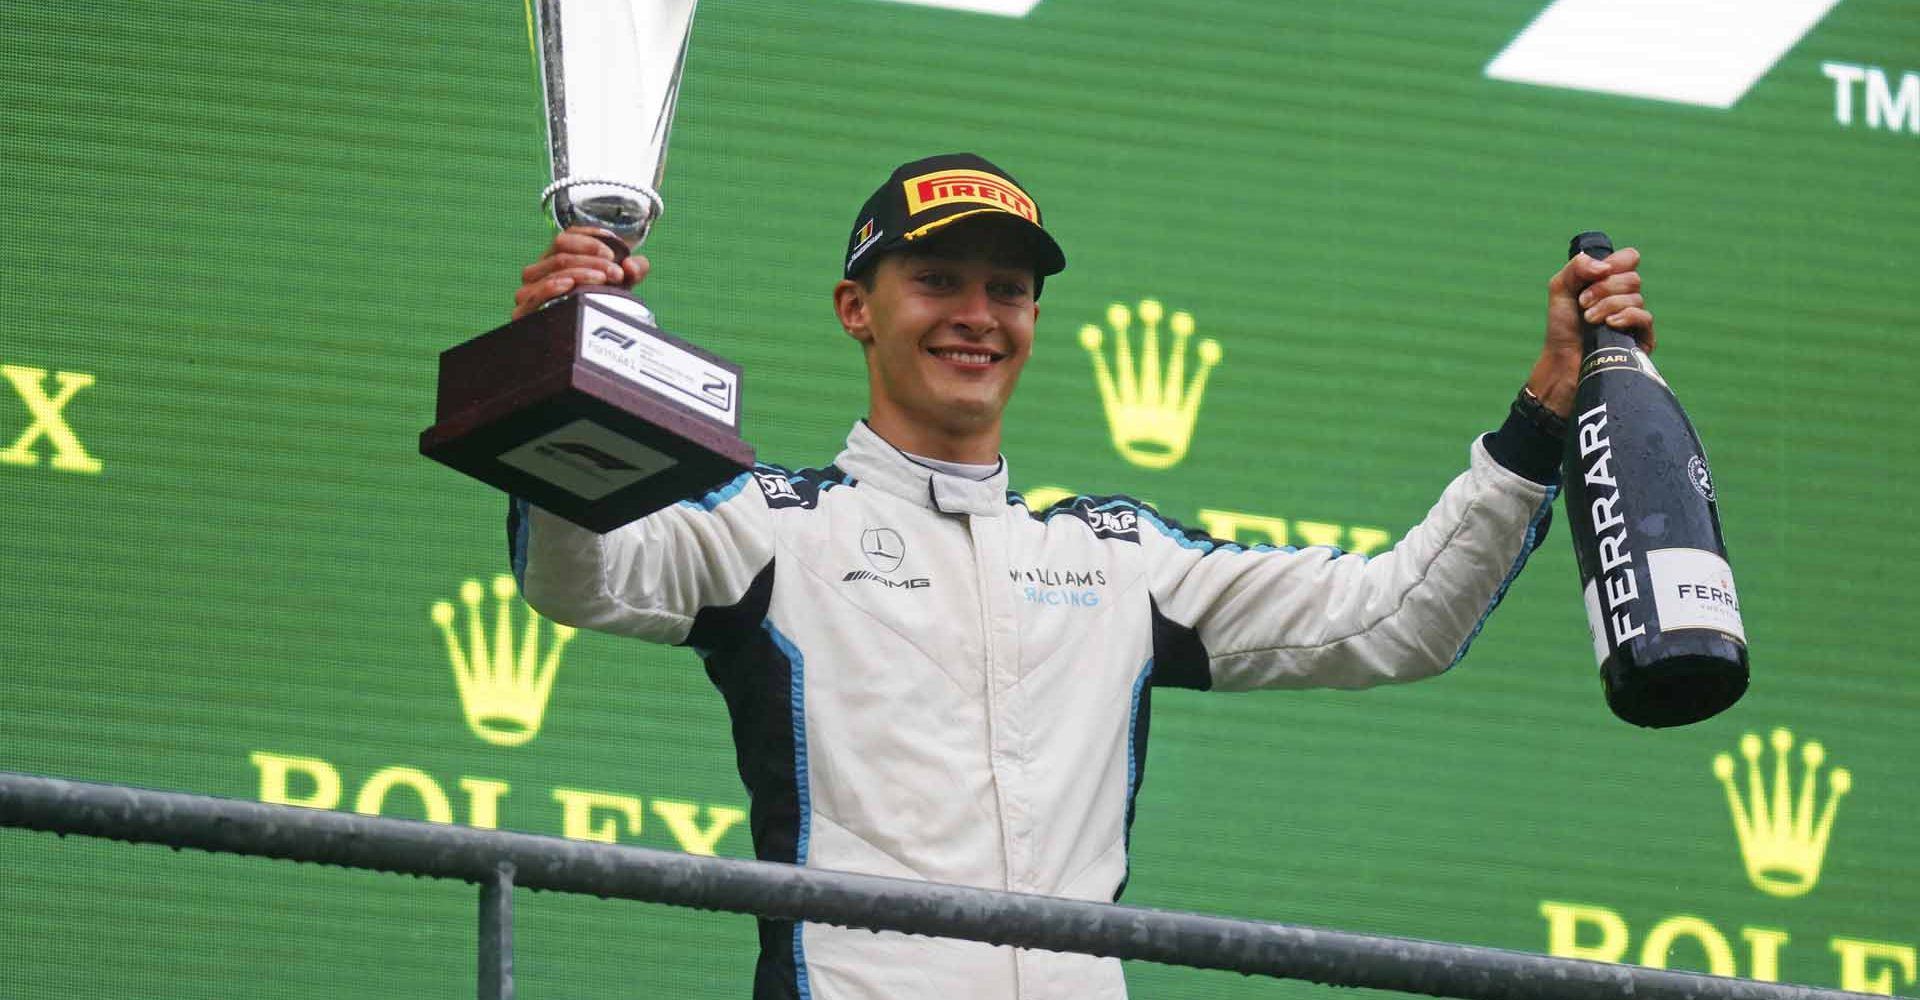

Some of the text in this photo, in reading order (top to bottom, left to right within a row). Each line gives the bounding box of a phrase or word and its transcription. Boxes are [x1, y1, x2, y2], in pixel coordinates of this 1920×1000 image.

[917, 176, 1033, 222] PIRELLI
[592, 327, 636, 350] F1
[759, 478, 797, 496] OM
[1697, 467, 1710, 490] 2
[1578, 402, 1646, 646] FERRARI
[872, 575, 930, 589] AMG
[1009, 568, 1106, 586] WILLIAMS
[1024, 586, 1100, 607] RACING
